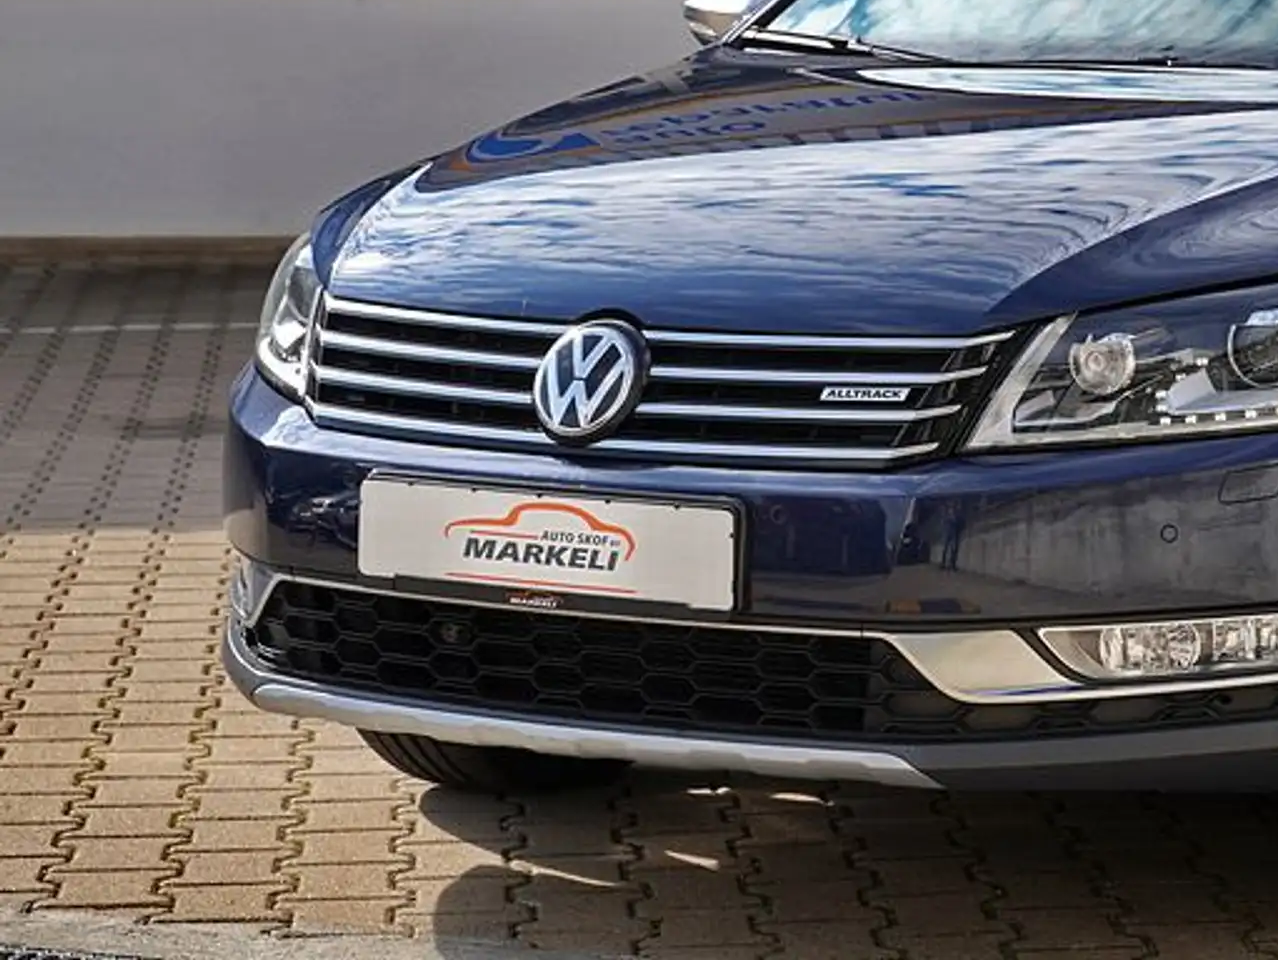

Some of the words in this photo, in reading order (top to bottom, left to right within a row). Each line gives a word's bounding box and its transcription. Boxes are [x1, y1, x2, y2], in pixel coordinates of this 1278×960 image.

[537, 324, 632, 434] VW
[826, 388, 903, 399] ALLTRACK
[541, 529, 575, 544] AUTO
[576, 532, 609, 547] SKOF
[463, 537, 619, 572] MARKELI
